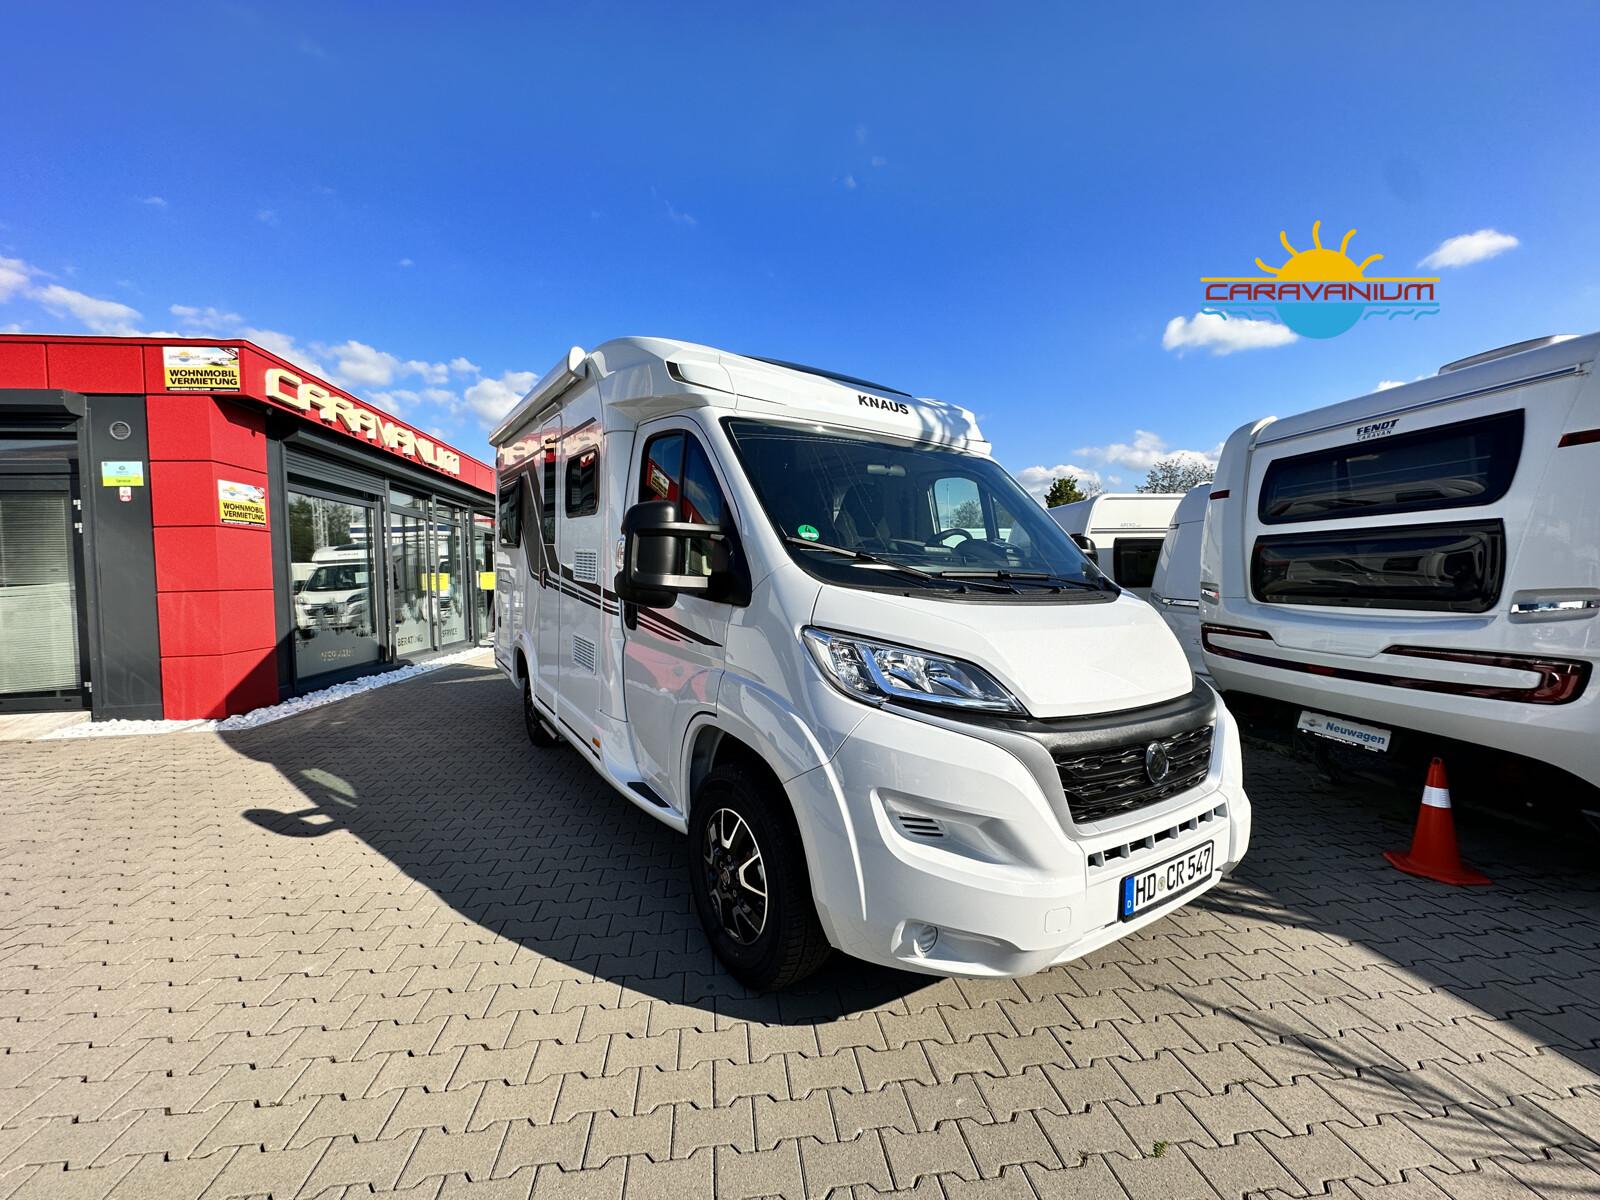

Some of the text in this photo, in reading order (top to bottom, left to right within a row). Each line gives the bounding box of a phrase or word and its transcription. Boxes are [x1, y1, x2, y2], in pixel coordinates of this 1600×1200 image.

[169, 369, 237, 377] WOHNMOBIL
[170, 377, 238, 385] VERMIETUNG
[858, 394, 909, 415] KNAUS
[1356, 418, 1400, 435] FENDT
[1357, 430, 1391, 441] CARAVAN
[223, 502, 264, 514] WOHNMOBIL
[223, 511, 265, 521] VERMIETUNG
[1325, 722, 1386, 744] Neuwagen
[1136, 847, 1211, 906] HD CR 547
